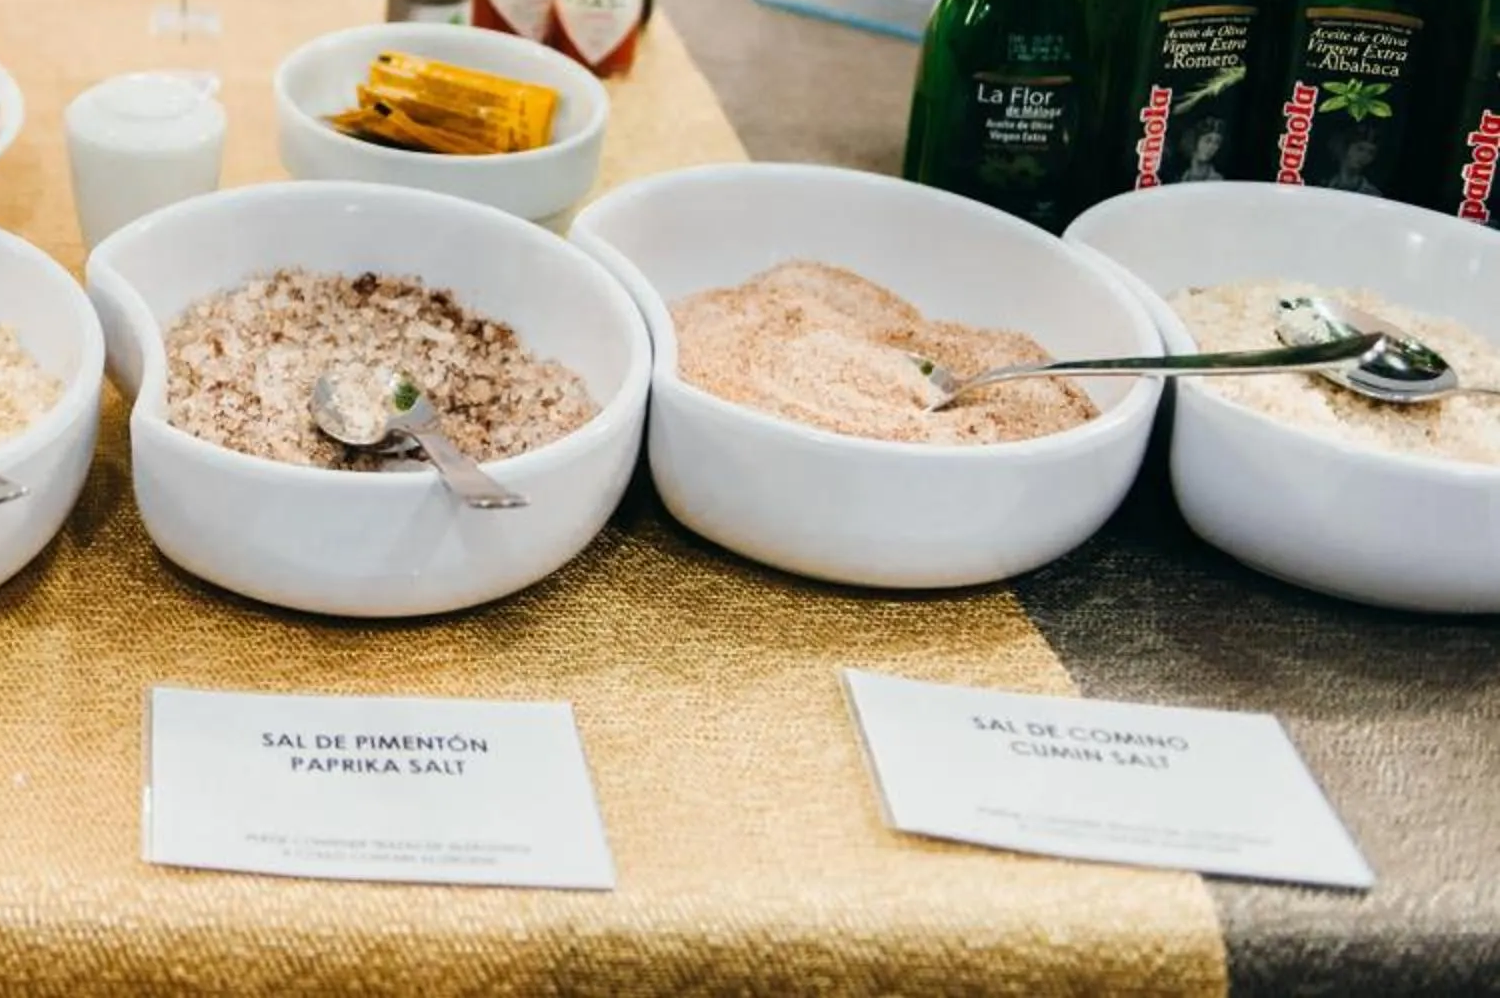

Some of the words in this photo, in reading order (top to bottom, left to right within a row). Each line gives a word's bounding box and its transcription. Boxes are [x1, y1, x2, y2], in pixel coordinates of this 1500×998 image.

[1163, 39, 1207, 55] Virgen
[1210, 38, 1247, 51] Extra
[1309, 27, 1351, 42] Aceite
[1352, 31, 1369, 43] de
[1372, 31, 1409, 48] Oliva
[1307, 38, 1359, 58] Virgen
[1362, 45, 1408, 62] Extra
[1172, 53, 1238, 69] Romero
[1318, 53, 1400, 77] Albahaca
[977, 83, 1003, 104] La
[1011, 87, 1054, 105] Flor
[261, 733, 308, 749] SAL
[316, 735, 348, 749] DE
[355, 734, 488, 753] PIMENTÓN
[971, 716, 1017, 733] SAL
[1026, 722, 1065, 739] DE
[1068, 727, 1189, 752] COMINO
[1010, 740, 1103, 763] CUMIN
[1111, 751, 1170, 769] SALT
[291, 756, 401, 773] PAPRIKA
[409, 759, 467, 775] SALT
